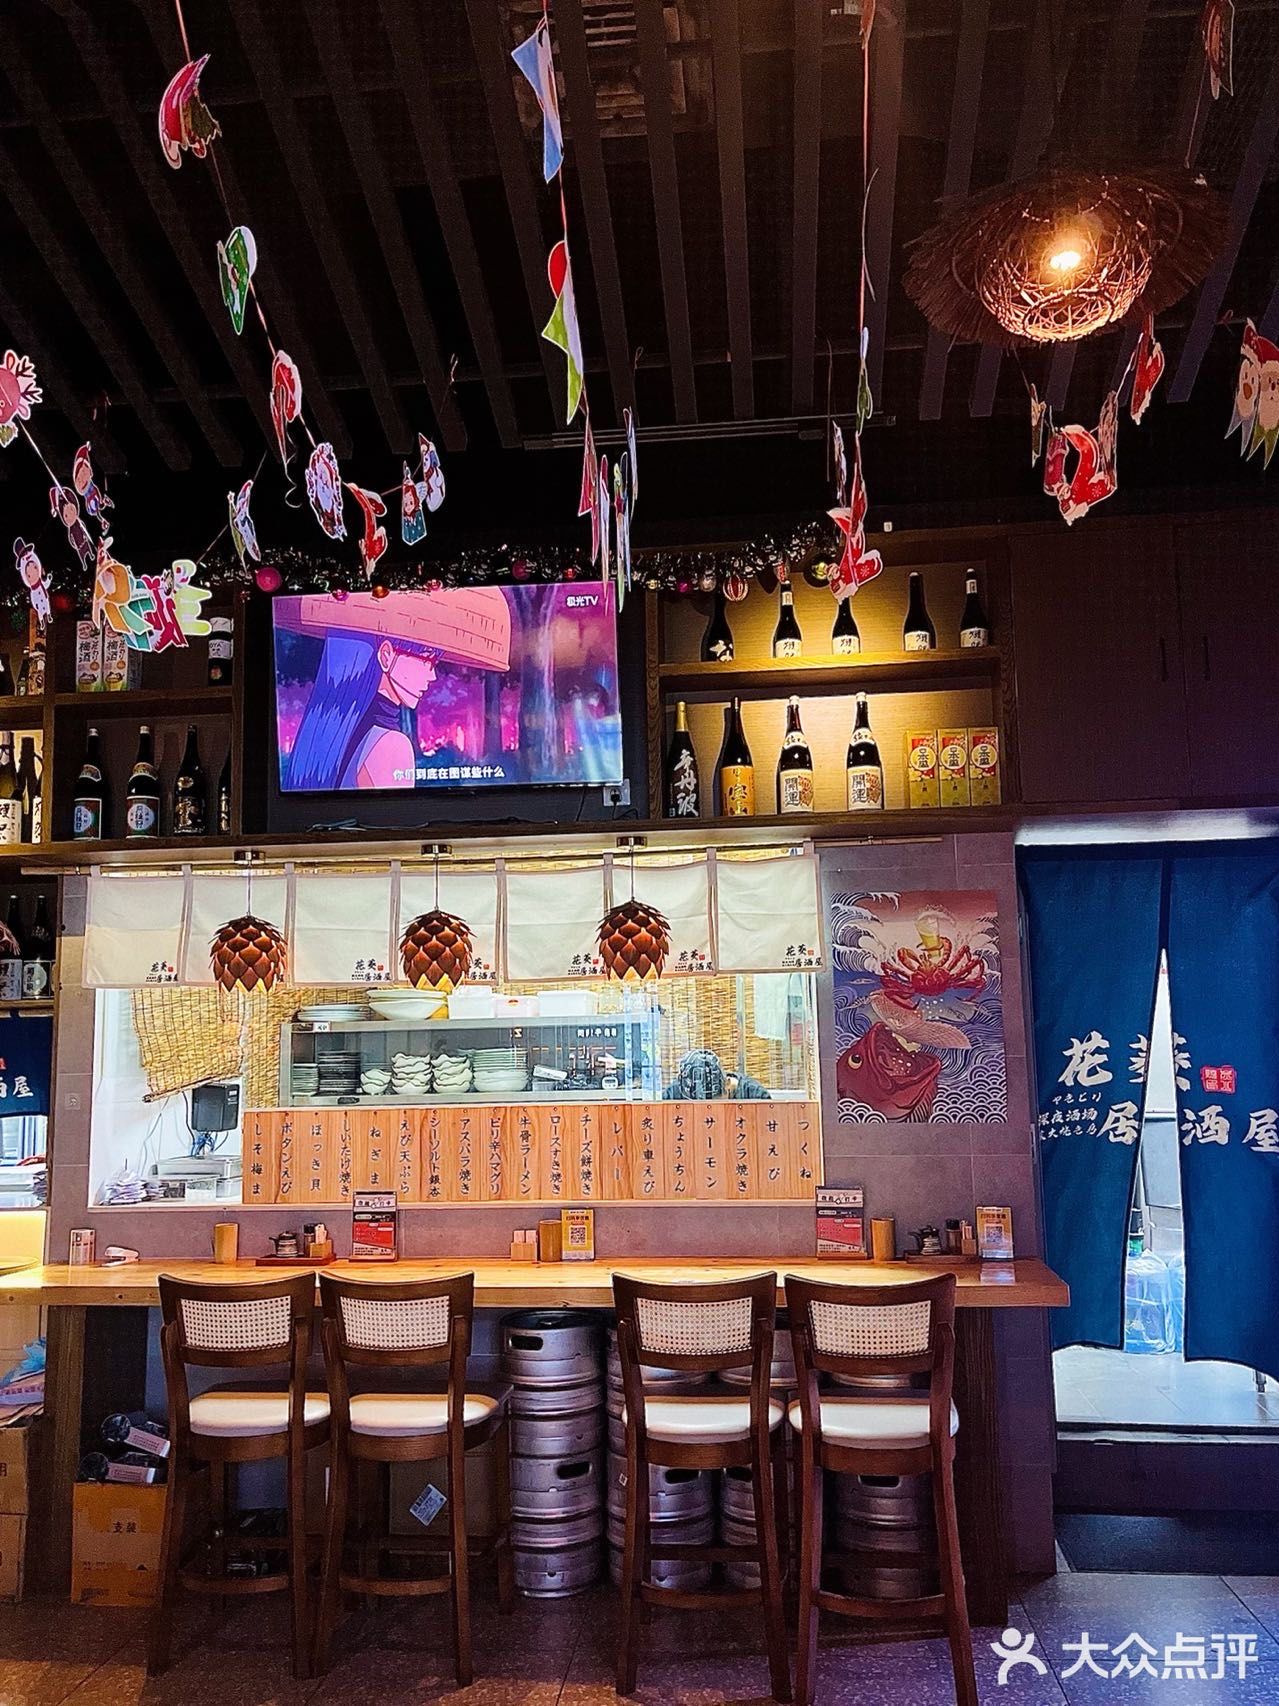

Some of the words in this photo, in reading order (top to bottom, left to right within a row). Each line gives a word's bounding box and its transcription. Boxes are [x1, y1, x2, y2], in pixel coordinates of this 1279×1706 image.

[393, 765, 505, 781] 你们到底在图谋些什么
[785, 775, 800, 807] 開運
[852, 774, 868, 804] 開運
[1052, 1091, 1103, 1105] やきとり
[1096, 1101, 1279, 1153] 居酒屋
[250, 1123, 263, 1195] しそ梅ま
[339, 1119, 352, 1197] しいたけ焼き
[519, 1116, 532, 1195] 牛骨ラーメン
[550, 1115, 562, 1195] ロースすき焼き
[673, 1115, 685, 1192] ちょうちん
[704, 1116, 717, 1189] サーモン
[735, 1117, 748, 1192] オクラ焼き
[766, 1120, 780, 1181] 甘えび
[798, 1120, 812, 1179] つくね
